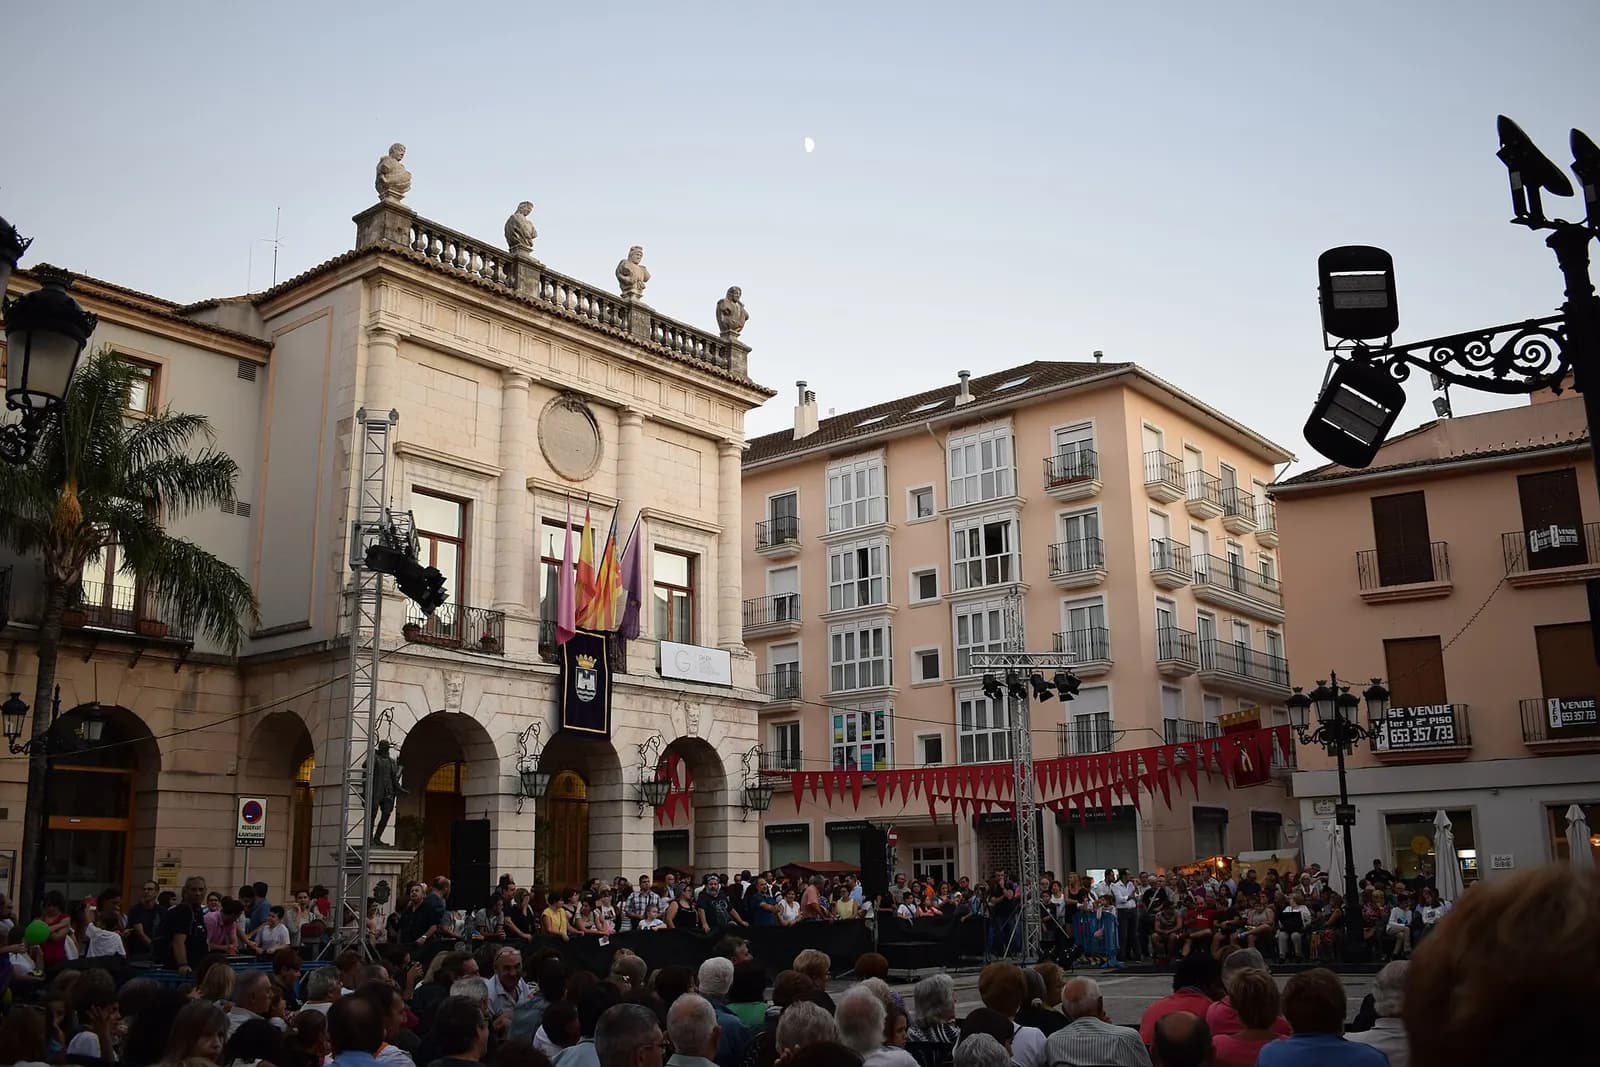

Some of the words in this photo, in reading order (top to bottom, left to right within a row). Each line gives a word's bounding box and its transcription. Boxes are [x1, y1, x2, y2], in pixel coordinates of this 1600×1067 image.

[1387, 707, 1405, 718] SE
[1407, 704, 1452, 716] VENDE
[1560, 700, 1596, 710] VENDE
[1406, 720, 1413, 728] y
[1428, 716, 1452, 725] PISO
[1390, 728, 1410, 743] 653
[1412, 726, 1431, 742] 357
[1433, 725, 1454, 741] 733
